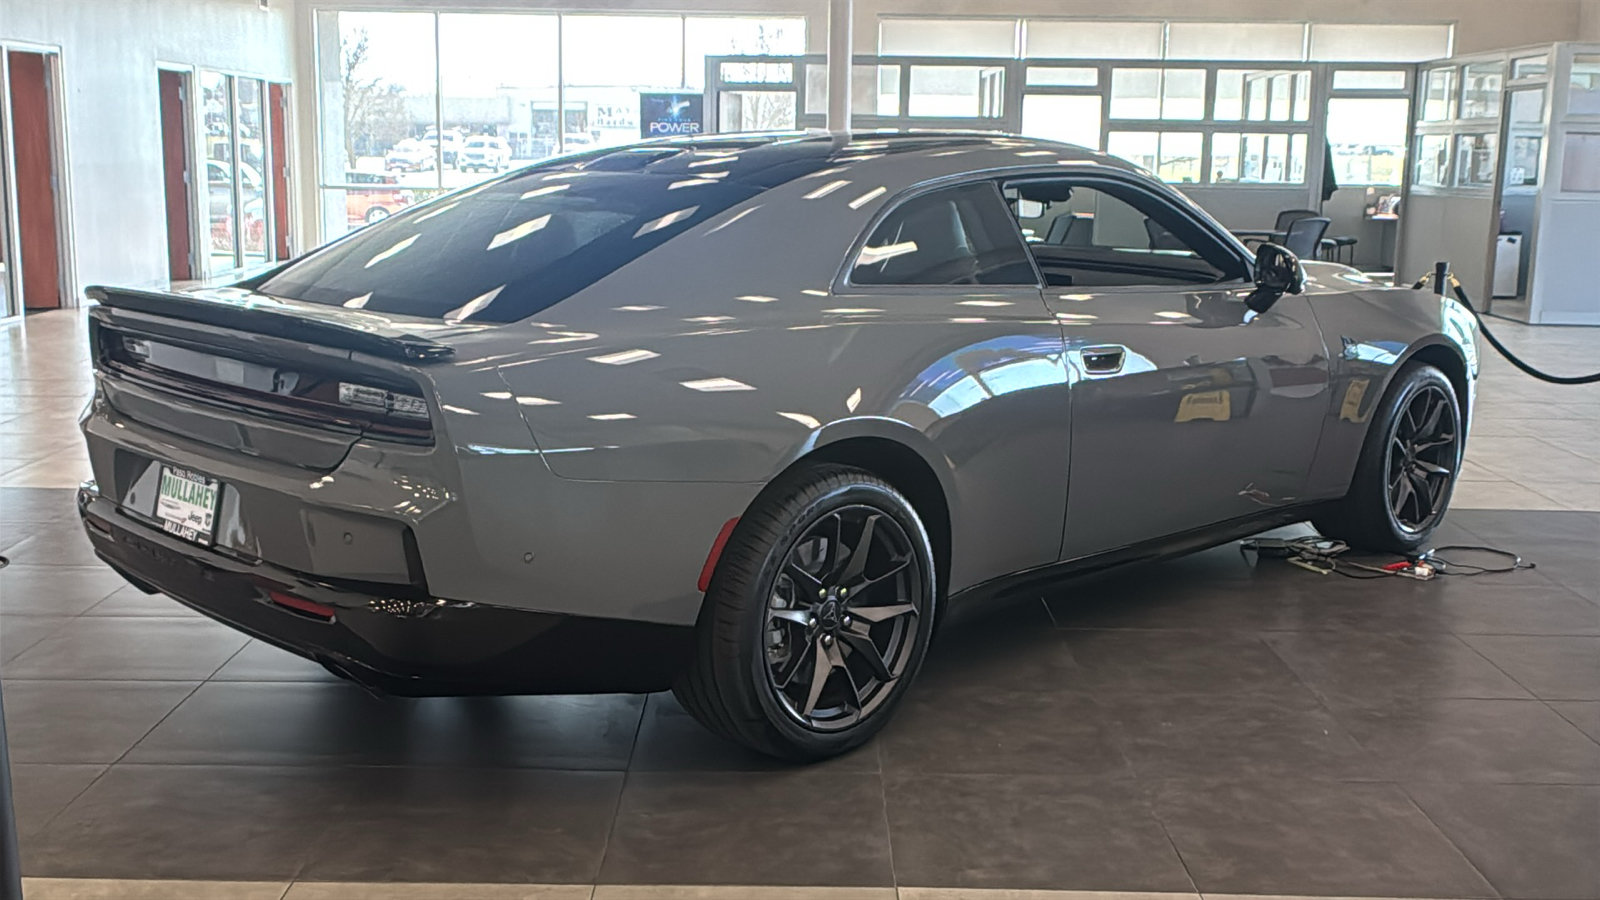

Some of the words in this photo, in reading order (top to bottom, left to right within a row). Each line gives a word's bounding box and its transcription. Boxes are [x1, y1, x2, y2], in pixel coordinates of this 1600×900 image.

[649, 122, 700, 133] POWER
[161, 474, 217, 510] MULLAHEY
[188, 511, 203, 525] Jeep
[163, 519, 198, 541] MULLAHEY
